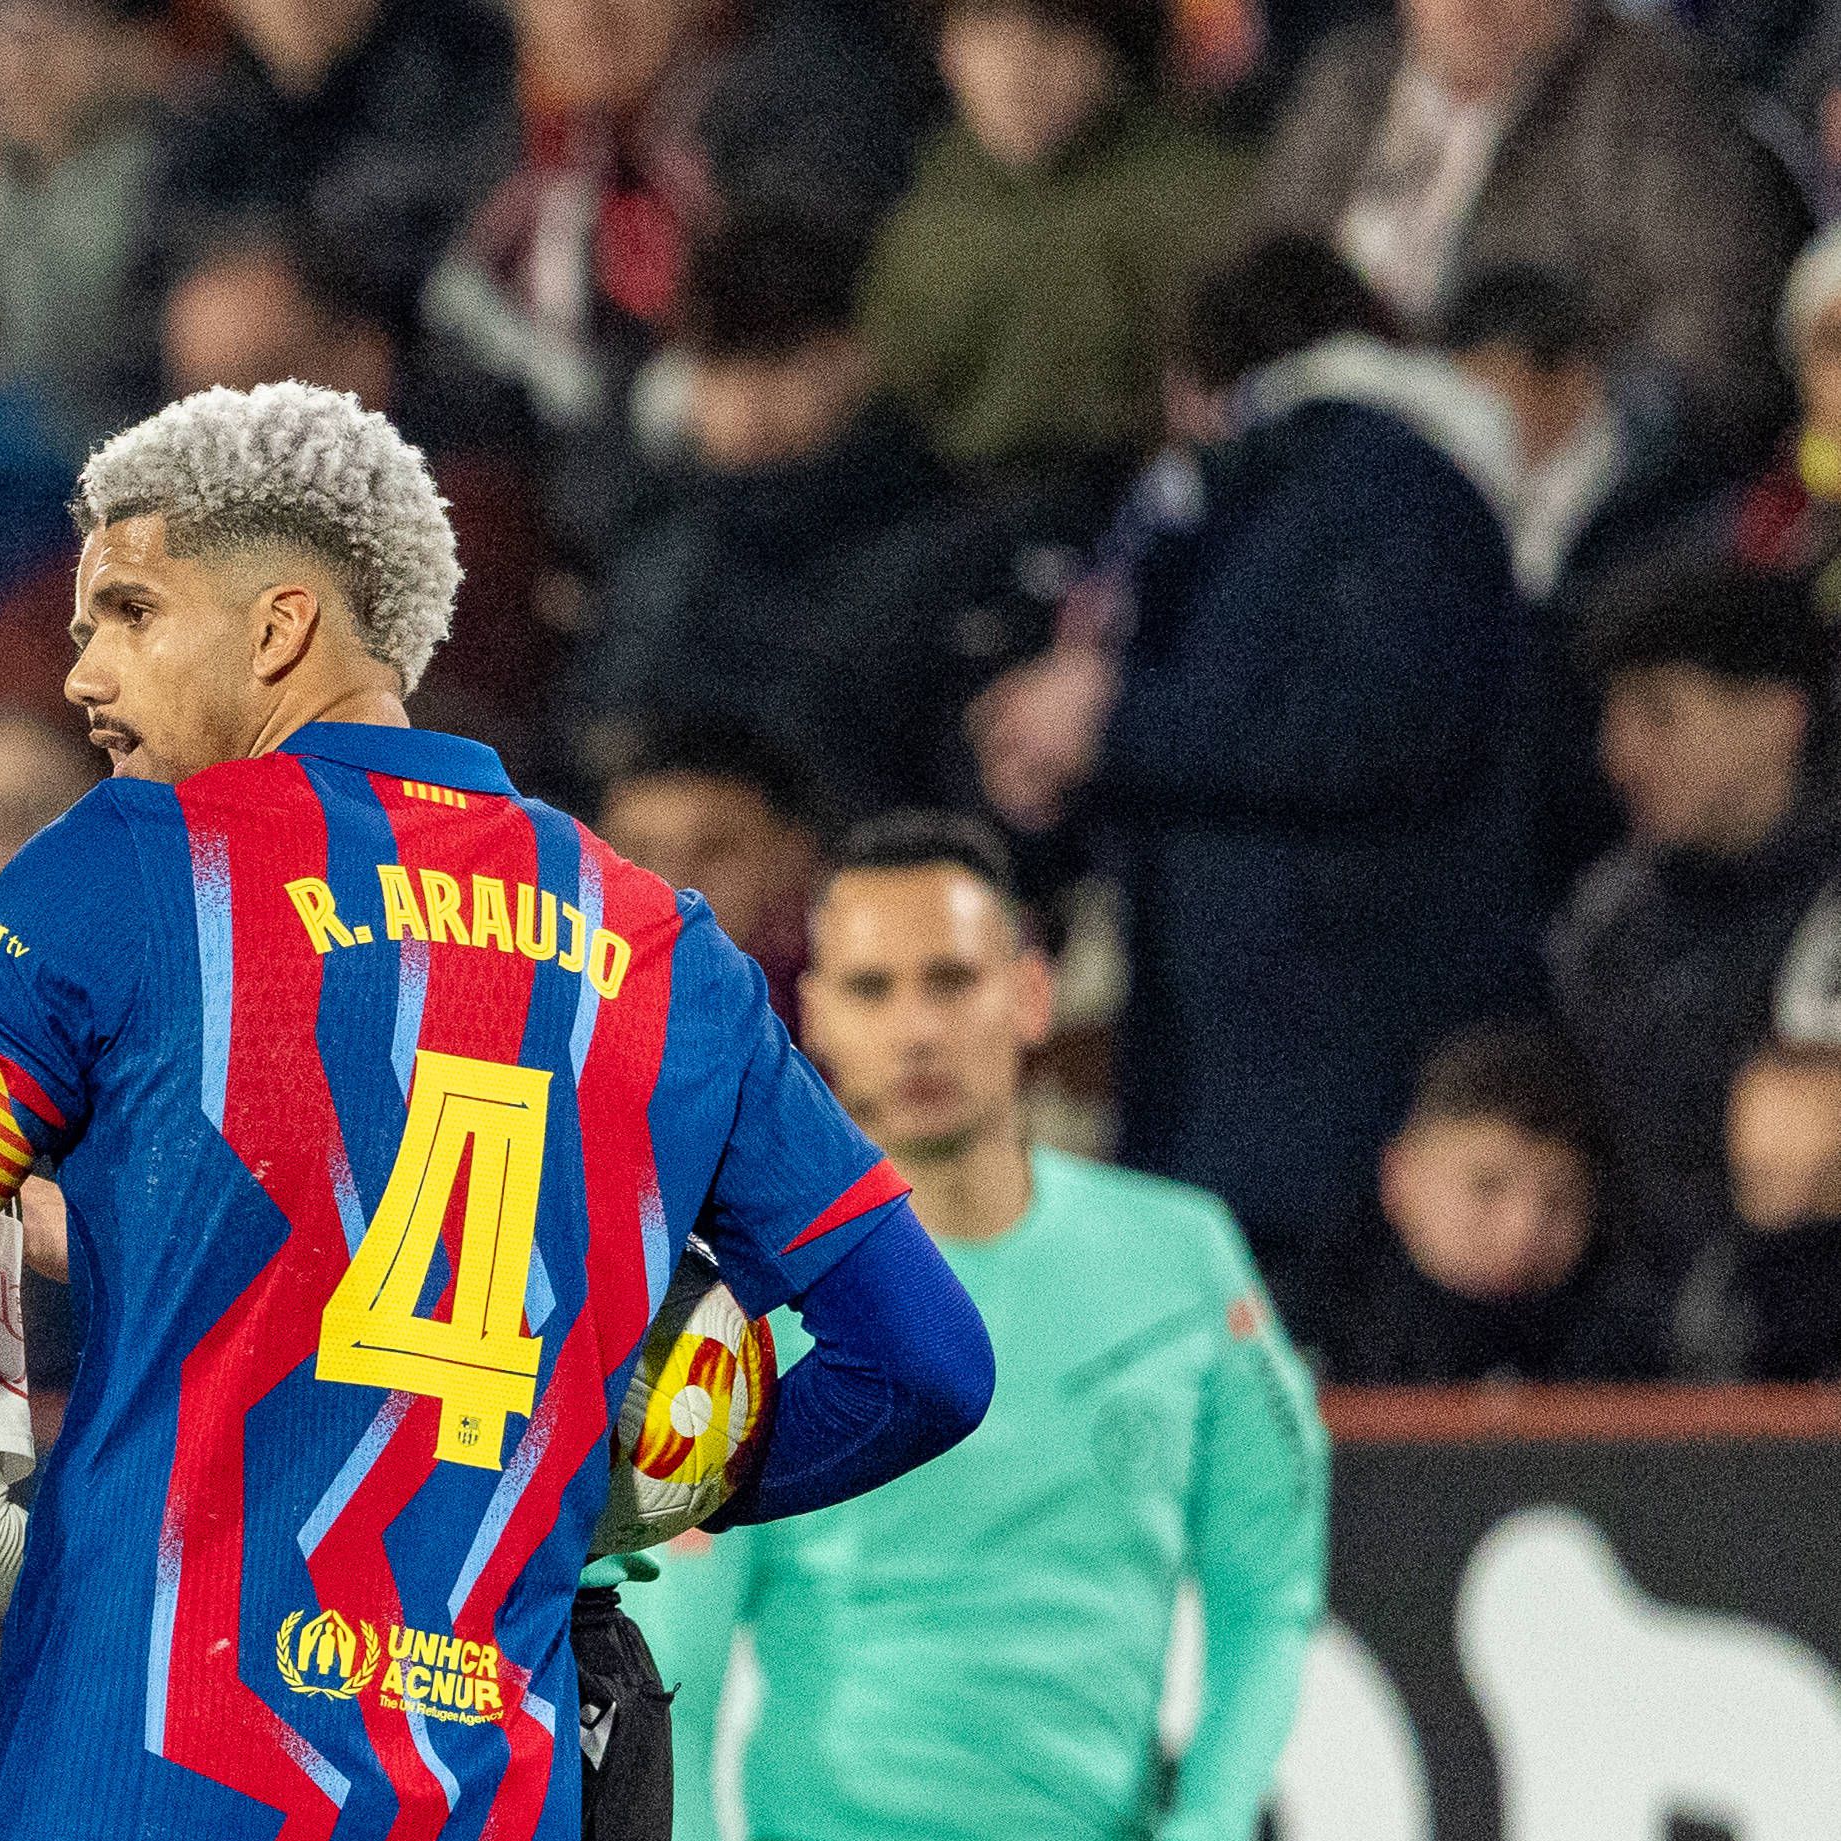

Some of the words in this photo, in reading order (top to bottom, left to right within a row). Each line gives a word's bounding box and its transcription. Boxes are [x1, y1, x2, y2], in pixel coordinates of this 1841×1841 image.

[6, 935, 31, 958] tv
[284, 877, 374, 955] R.
[377, 865, 632, 1000] ARAUJO
[317, 1049, 553, 1471] 4
[387, 1624, 499, 1679] UNHCR
[380, 1660, 504, 1711] ACNUR
